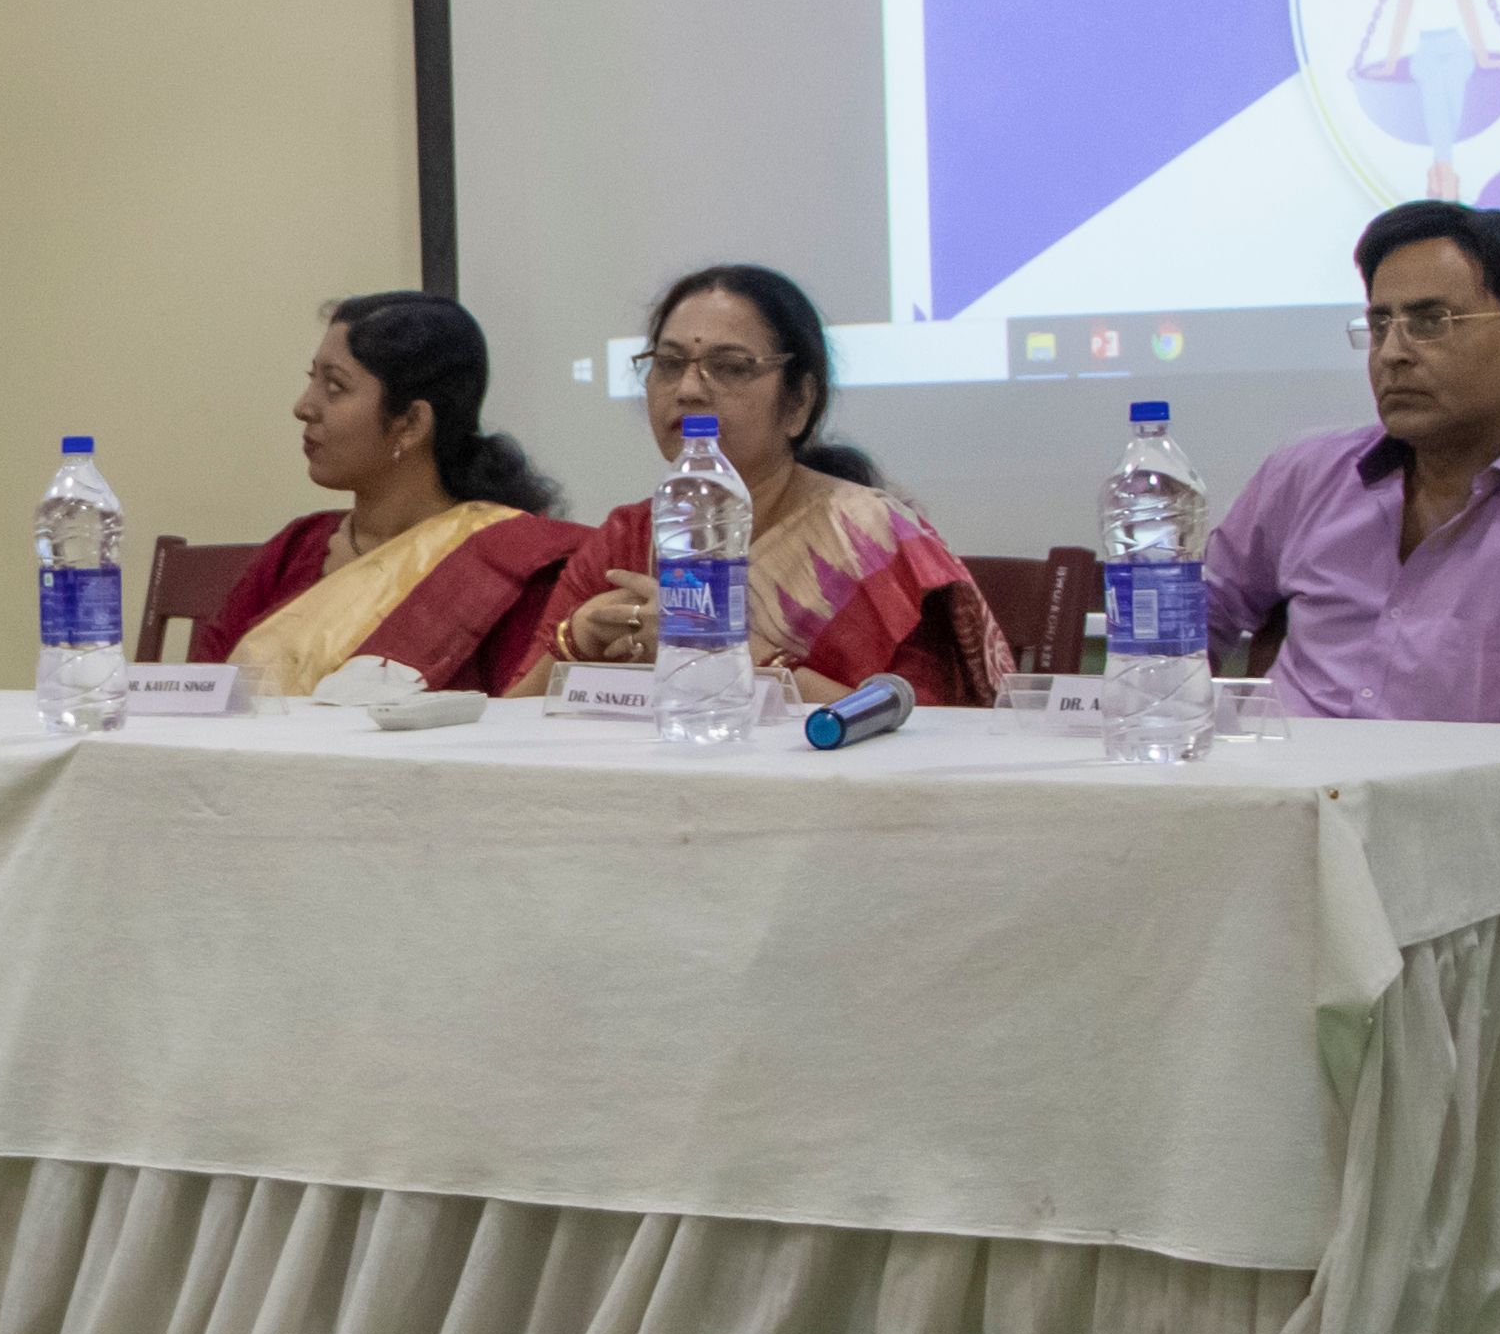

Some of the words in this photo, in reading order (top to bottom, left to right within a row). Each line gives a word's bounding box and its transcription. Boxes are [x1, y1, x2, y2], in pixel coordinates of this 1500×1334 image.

[568, 689, 590, 703] DR.
[595, 691, 648, 707] SANJEEV
[1060, 698, 1085, 711] DR.
